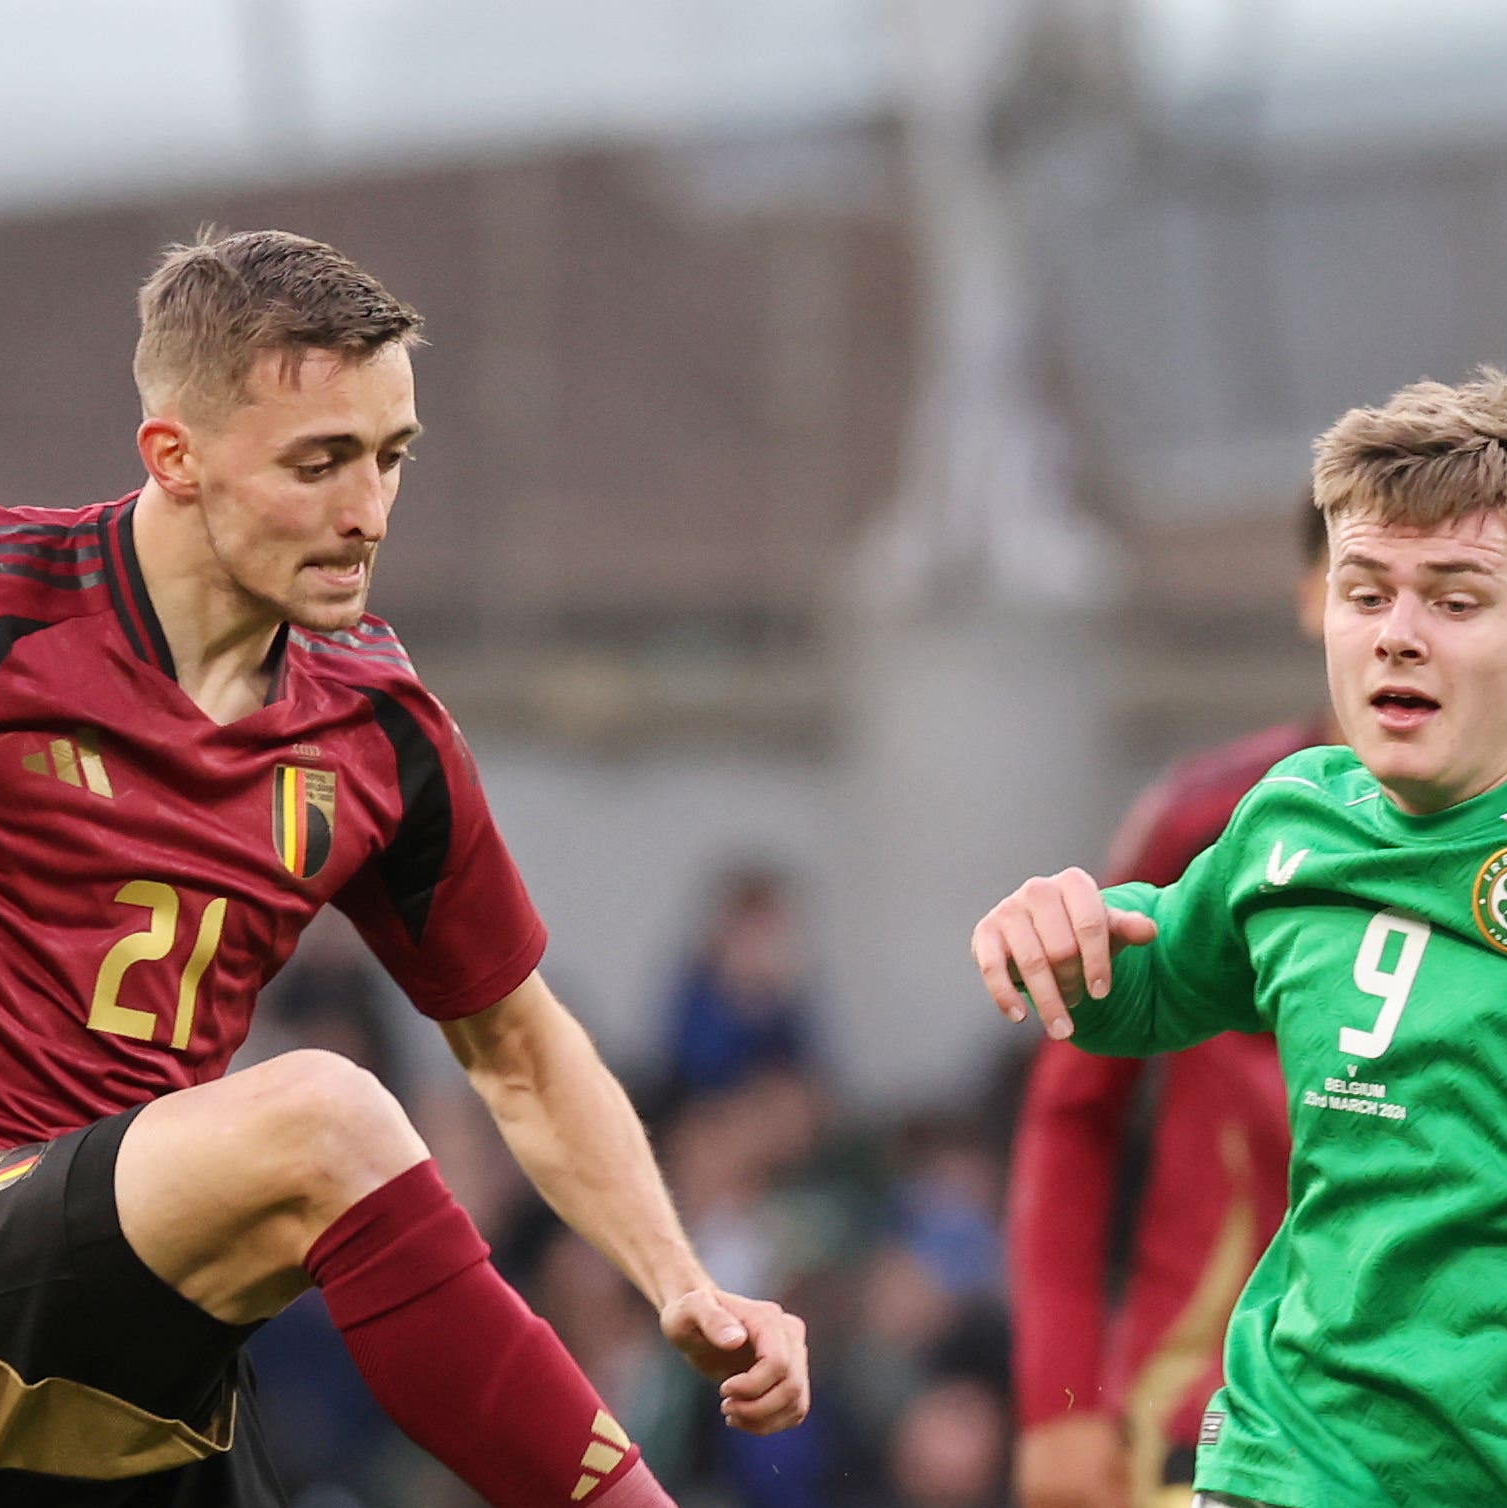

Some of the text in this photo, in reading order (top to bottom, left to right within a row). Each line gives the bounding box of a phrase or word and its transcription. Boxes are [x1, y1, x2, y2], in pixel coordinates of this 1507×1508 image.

[86, 880, 228, 1050] 21
[1339, 906, 1432, 1060] 9
[1324, 1077, 1386, 1098] BELGIUM
[1328, 1096, 1378, 1115] MARCH
